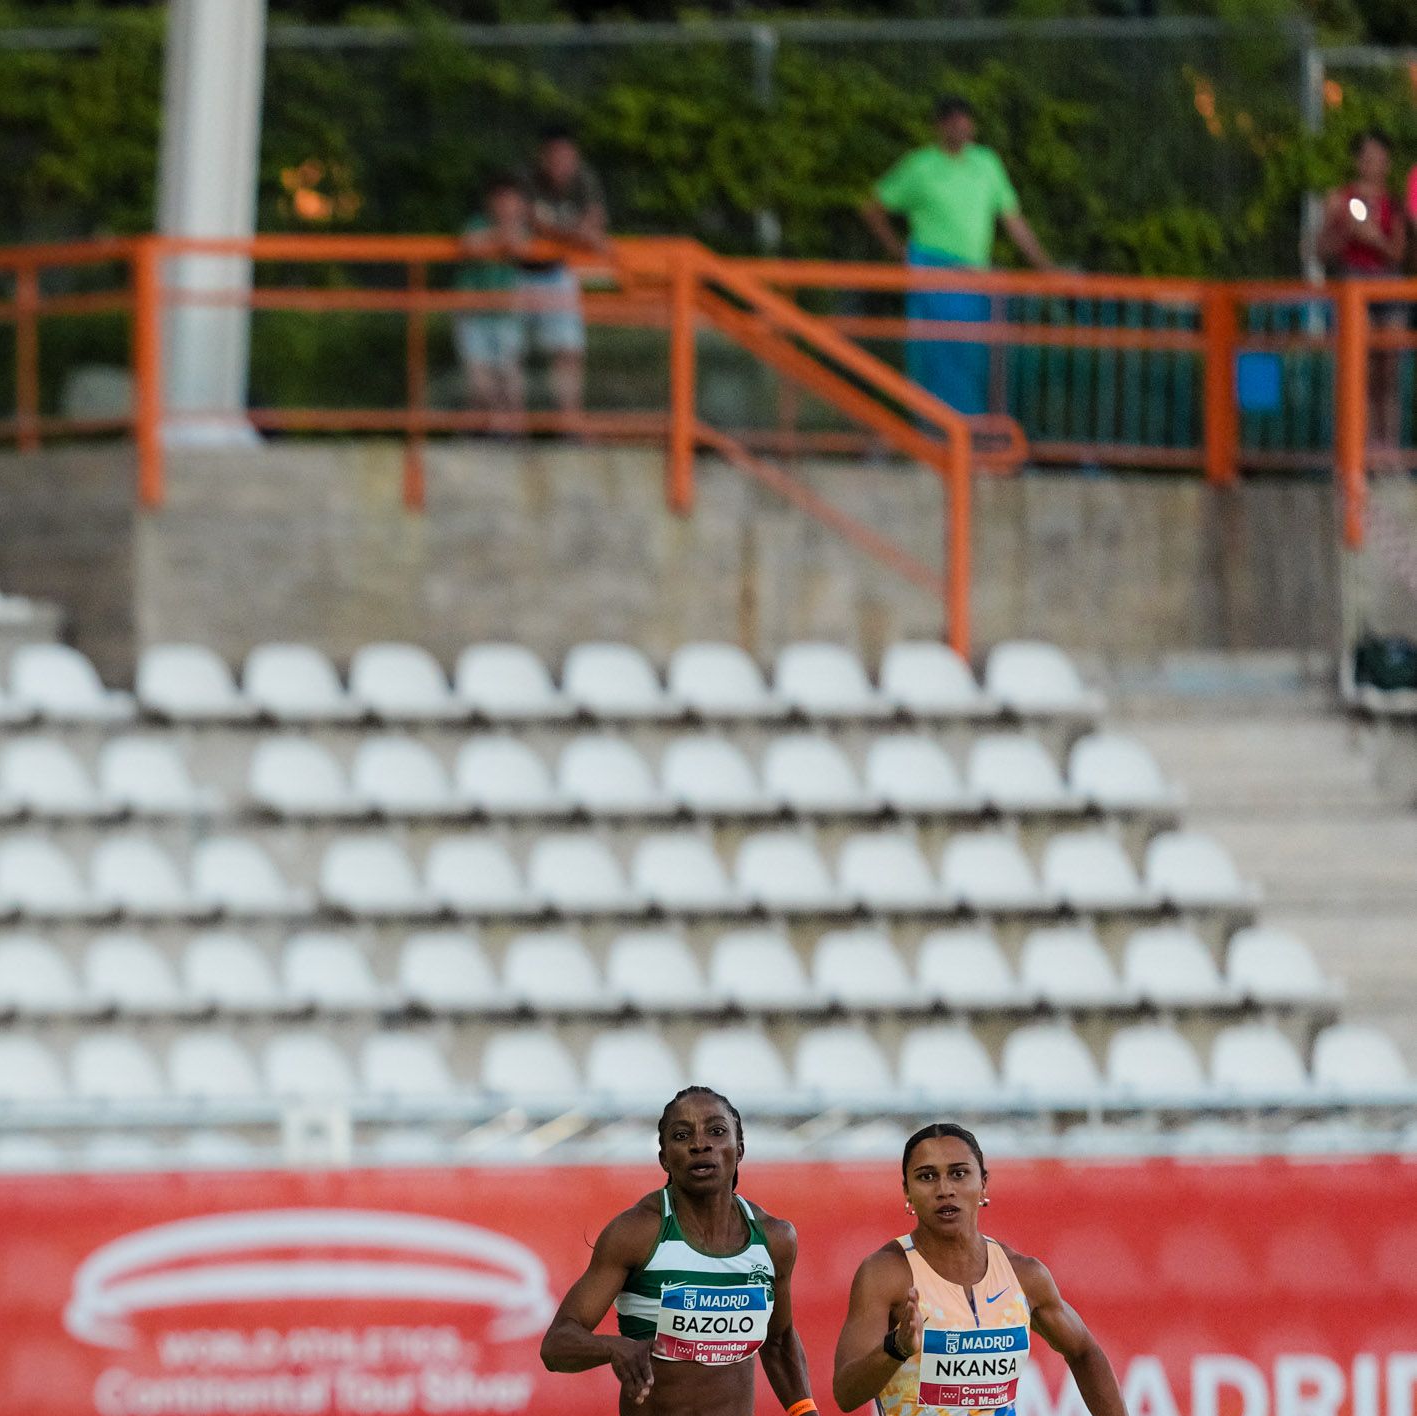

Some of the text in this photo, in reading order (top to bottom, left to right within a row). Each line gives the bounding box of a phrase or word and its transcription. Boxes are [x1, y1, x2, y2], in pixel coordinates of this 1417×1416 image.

[699, 1294, 750, 1310] MADRID
[672, 1315, 754, 1334] BAZOLO
[696, 1342, 748, 1351] Comunidad
[961, 1335, 1015, 1351] MADRID
[695, 1352, 745, 1363] de Madrid
[935, 1358, 1017, 1377] NKANSA
[961, 1396, 976, 1405] de
